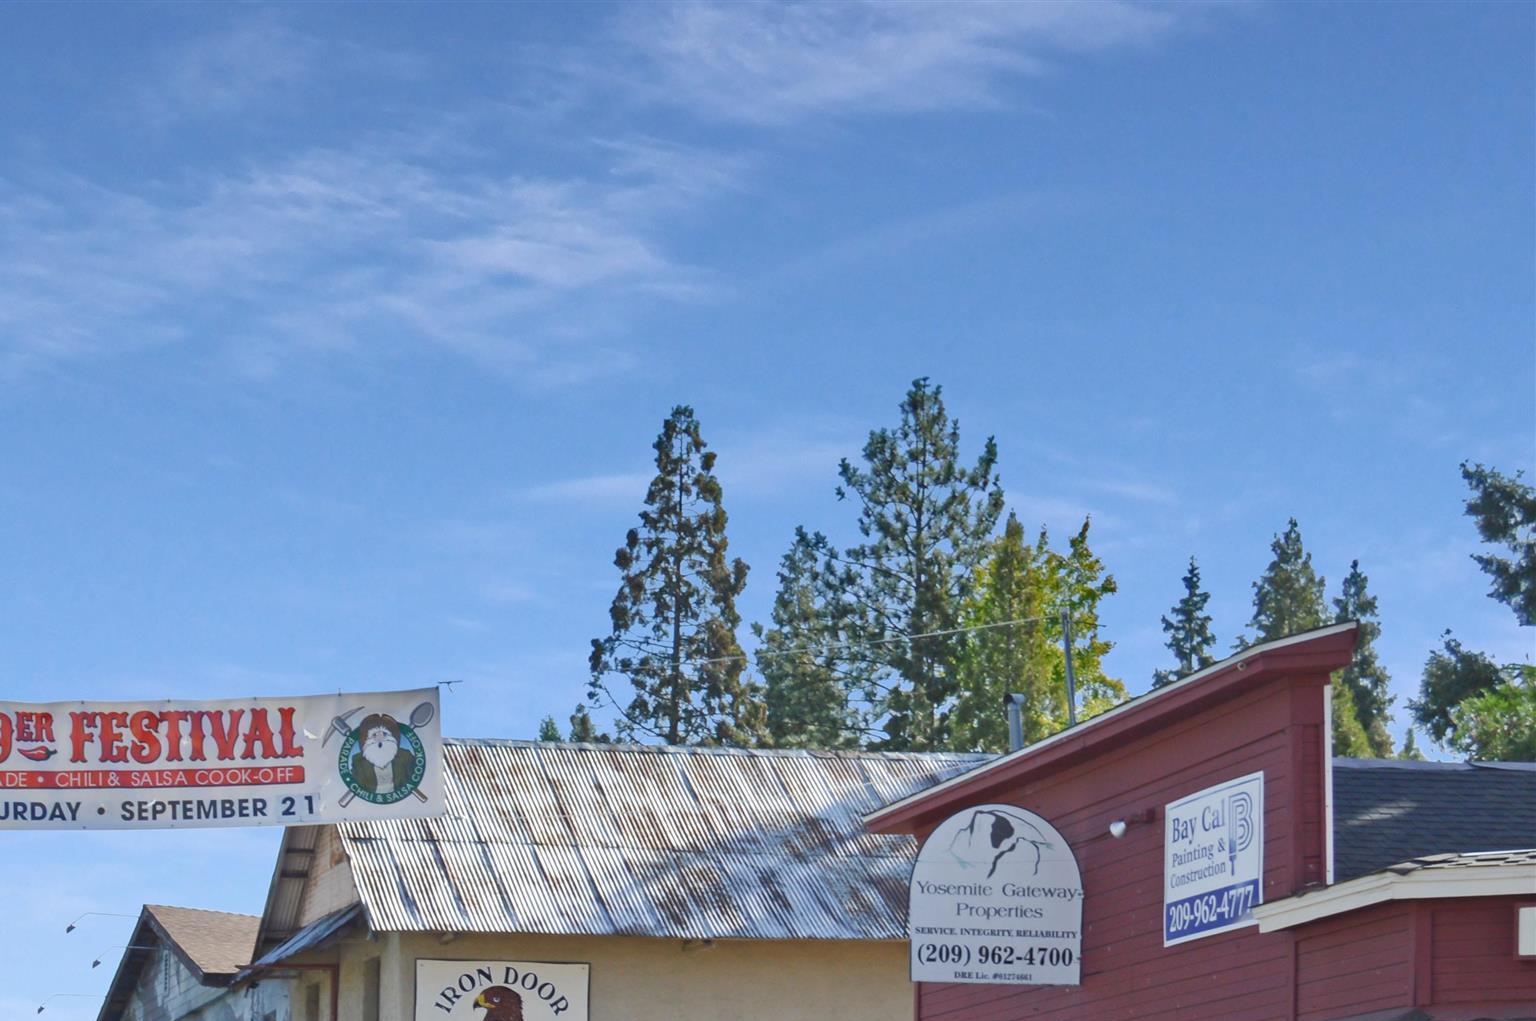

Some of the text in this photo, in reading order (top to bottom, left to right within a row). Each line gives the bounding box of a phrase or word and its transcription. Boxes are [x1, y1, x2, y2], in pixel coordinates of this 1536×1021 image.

[68, 707, 304, 763] FESTIVAL
[339, 736, 355, 774] PARADE
[55, 773, 103, 787] CHILI
[108, 773, 120, 786] &
[131, 771, 188, 786] SALSA
[195, 768, 294, 785] COOK-OFF
[350, 783, 374, 801] CHILI
[375, 792, 384, 802] &
[384, 783, 414, 802] SALSA
[121, 798, 267, 821] SEPTEMBER
[1172, 798, 1225, 845] Bay Cal
[1172, 837, 1226, 868] Painting &
[1170, 862, 1226, 889] Construction
[916, 880, 1078, 901] Yosemite Gateway
[956, 902, 1044, 920] Properties
[1169, 885, 1254, 933] 209-962-4777
[1015, 930, 1077, 939] RELIABILITY
[917, 944, 1073, 967] (209) 962-4700
[954, 971, 974, 979] DRE
[975, 971, 990, 980] Lic.
[434, 966, 569, 1016] IRON DOOR
